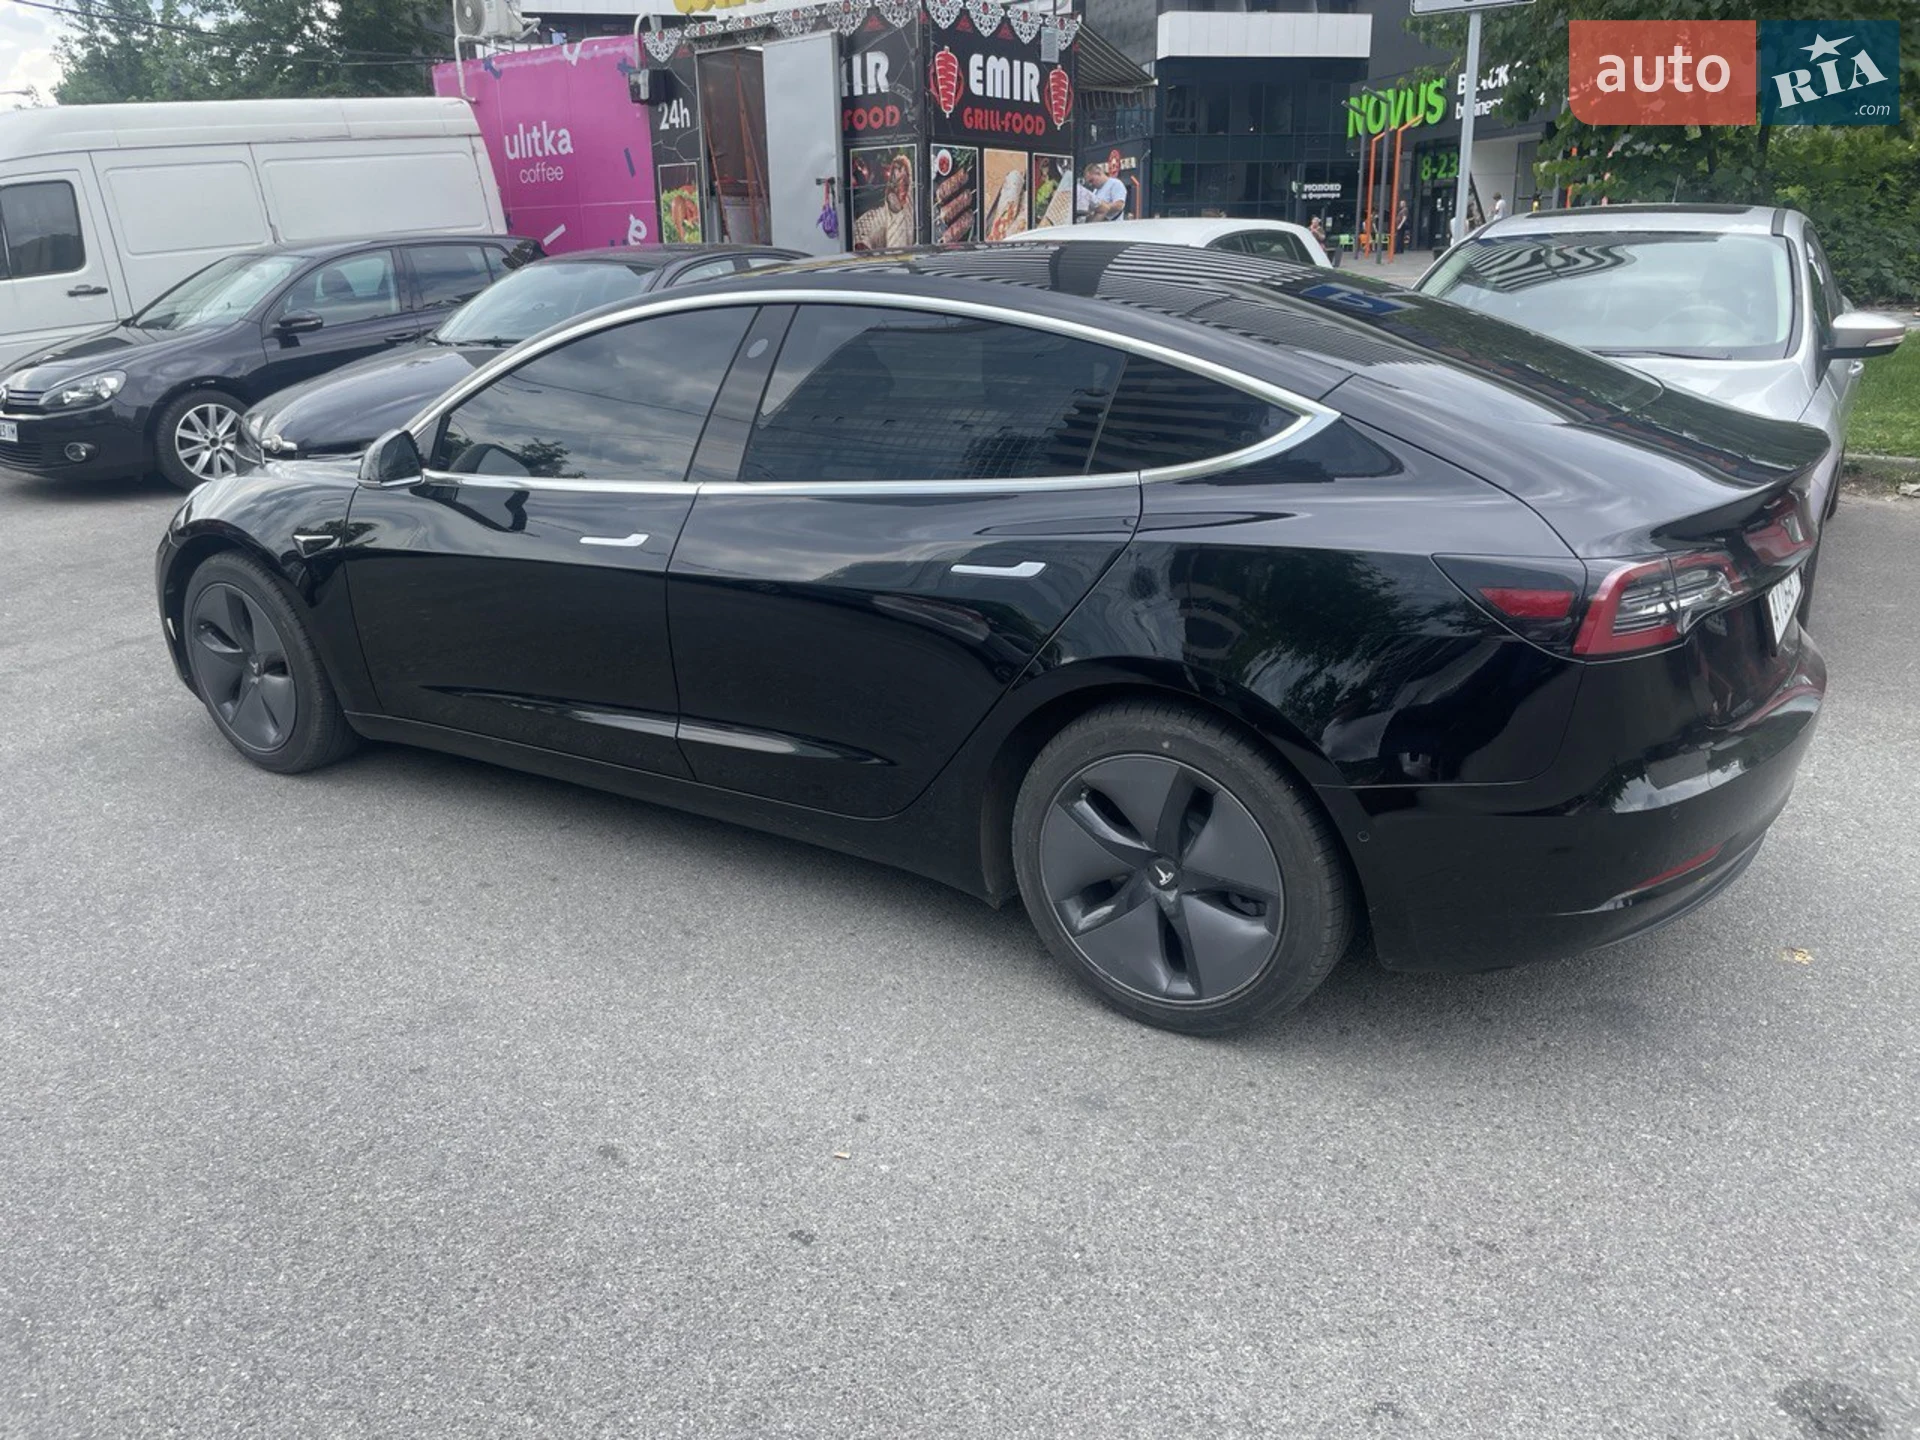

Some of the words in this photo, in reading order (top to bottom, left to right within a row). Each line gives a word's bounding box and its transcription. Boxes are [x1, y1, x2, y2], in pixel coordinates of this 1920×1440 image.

[841, 51, 890, 98] IR
[968, 53, 1041, 103] EMIR
[658, 98, 691, 130] 24h
[963, 106, 1046, 136] GRILL-FOOD
[1347, 78, 1447, 138] NOVUS
[504, 121, 574, 160] ulitka
[519, 161, 564, 183] coffee
[1421, 151, 1459, 180] 8-23
